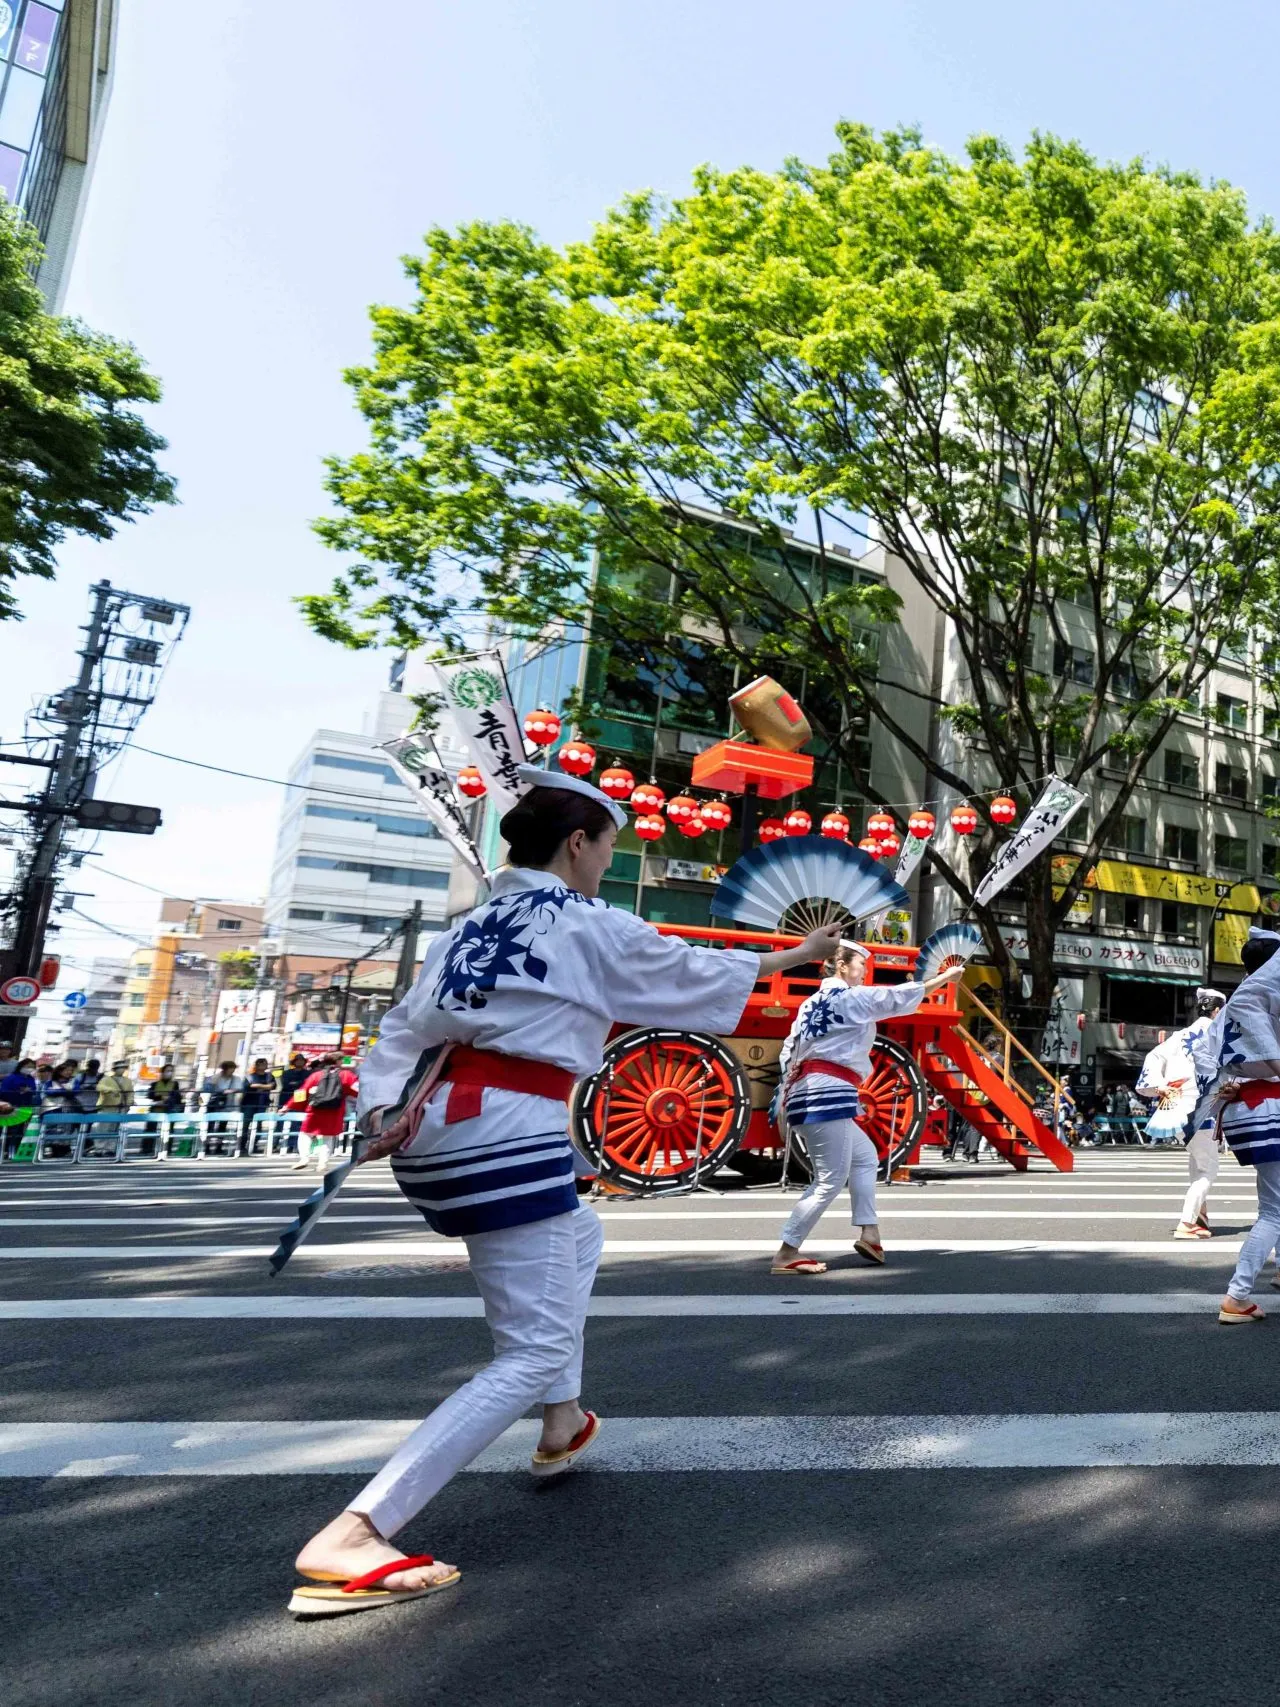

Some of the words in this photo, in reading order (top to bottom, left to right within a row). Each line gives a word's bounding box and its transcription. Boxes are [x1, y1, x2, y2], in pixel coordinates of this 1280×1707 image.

[473, 709, 528, 800] 青葉
[1004, 936, 1029, 950] オケ
[1100, 946, 1147, 961] カラオケ
[10, 984, 33, 997] 30
